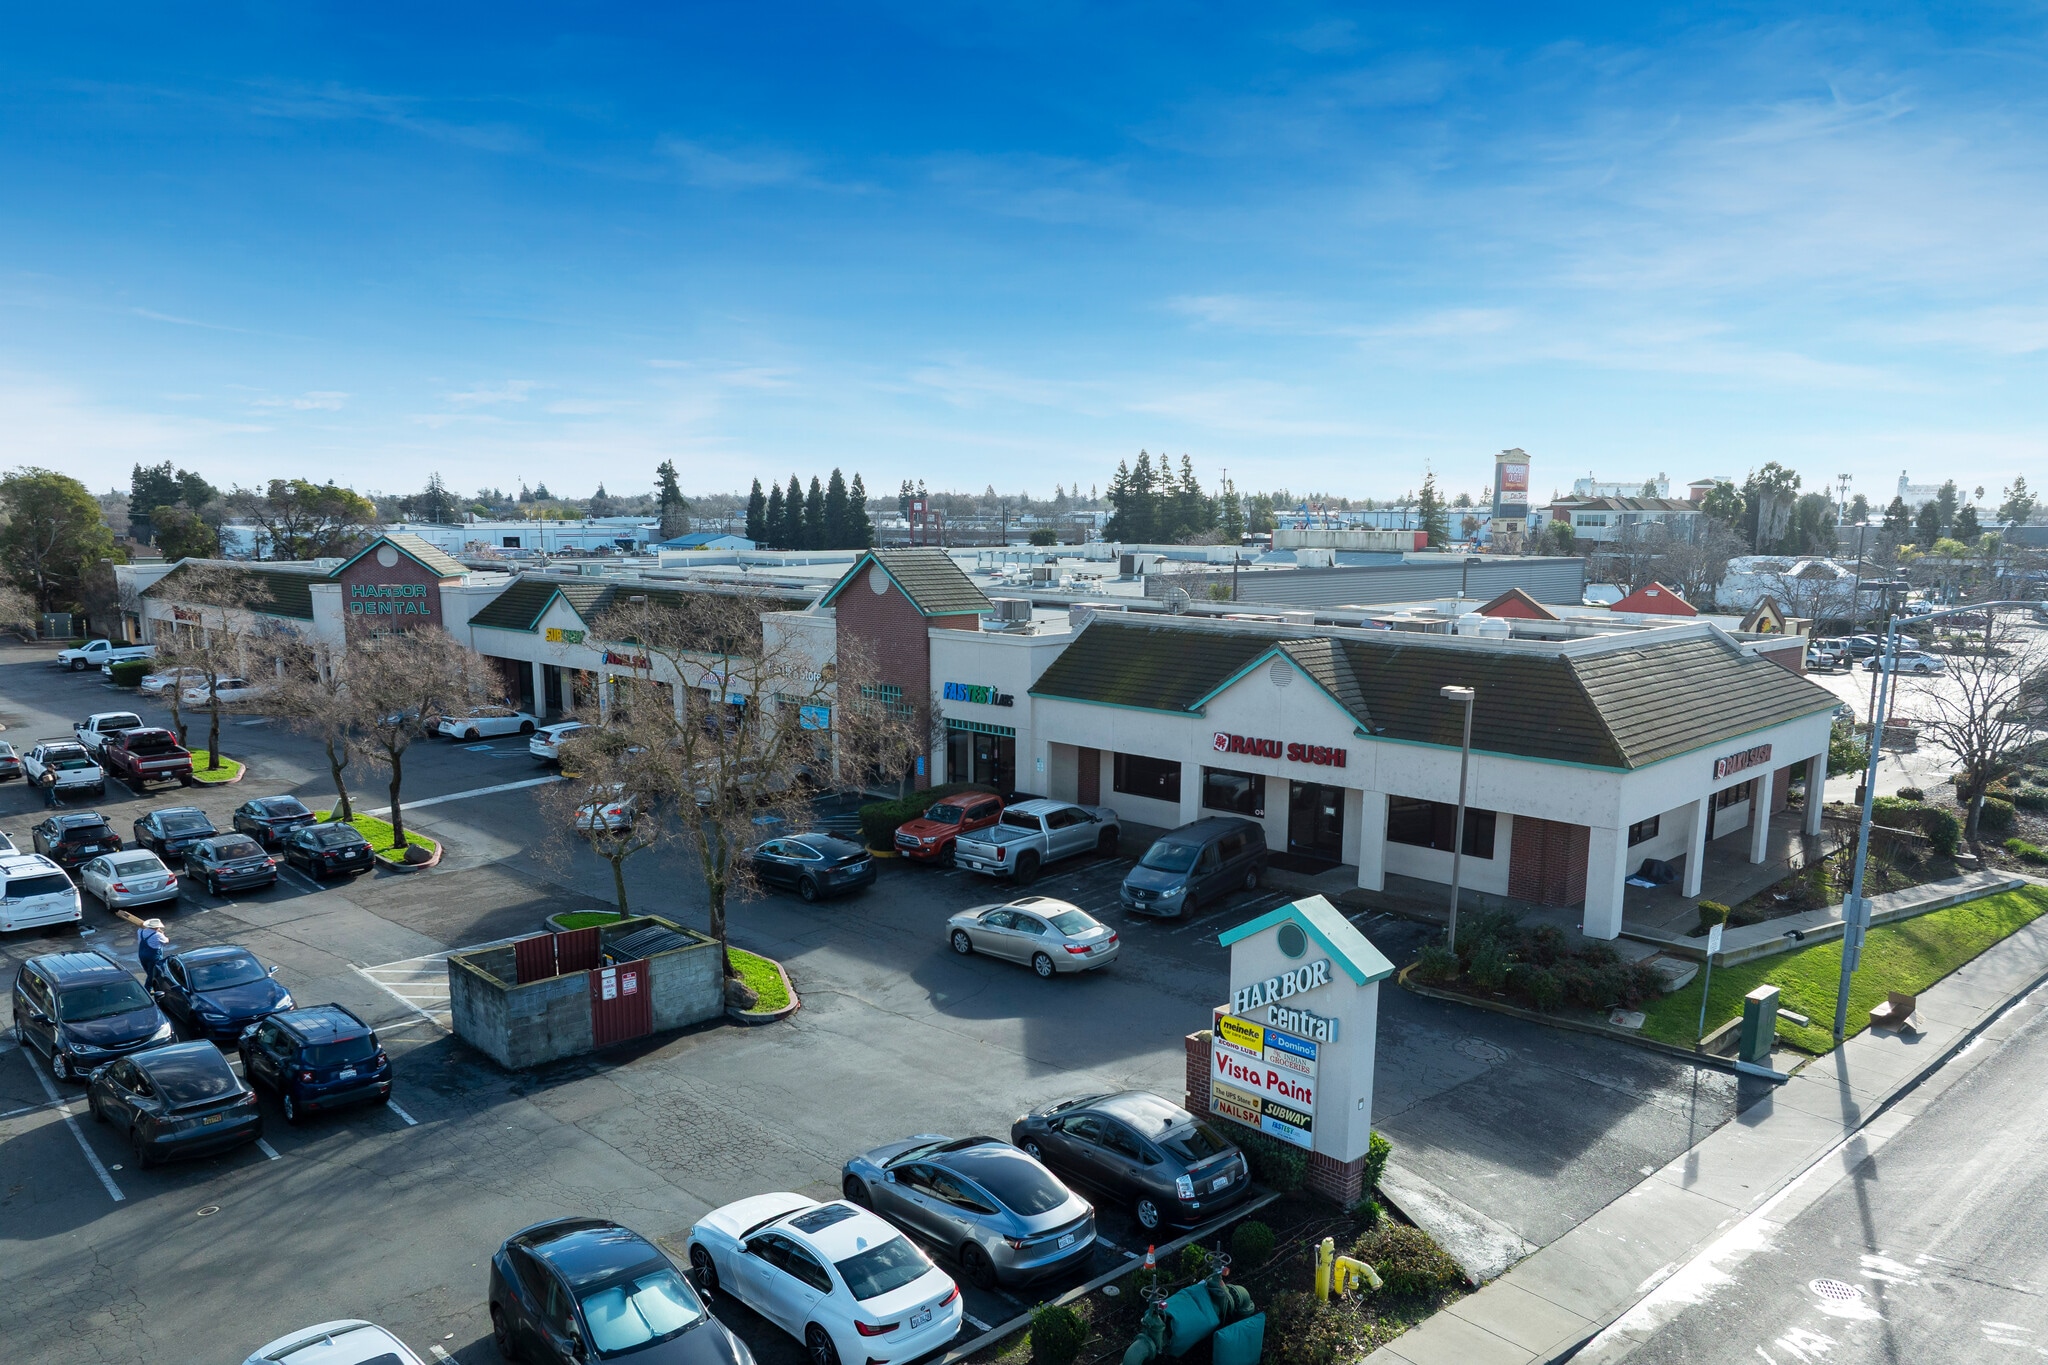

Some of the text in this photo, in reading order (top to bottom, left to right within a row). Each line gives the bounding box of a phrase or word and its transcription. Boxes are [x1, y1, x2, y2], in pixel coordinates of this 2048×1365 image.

[350, 602, 430, 615] DENTAL
[944, 682, 1014, 707] FASTEST LABS
[1232, 735, 1346, 768] RAKU SUSHI
[1726, 752, 1749, 776] RAKU
[1232, 959, 1331, 1016] HARBOR
[1223, 1021, 1259, 1039] meineke
[1267, 1004, 1337, 1044] central
[1218, 1038, 1258, 1057] ECONO LUBE
[1278, 1038, 1316, 1056] Domino's
[1270, 1055, 1310, 1074] GROCERIES
[1284, 1054, 1307, 1066] INDIAN
[1216, 1052, 1312, 1105] Vista Paint
[1215, 1087, 1251, 1105] The UPS Store
[1219, 1101, 1260, 1126] NAIL SPA
[1265, 1103, 1310, 1126] SUBWAY
